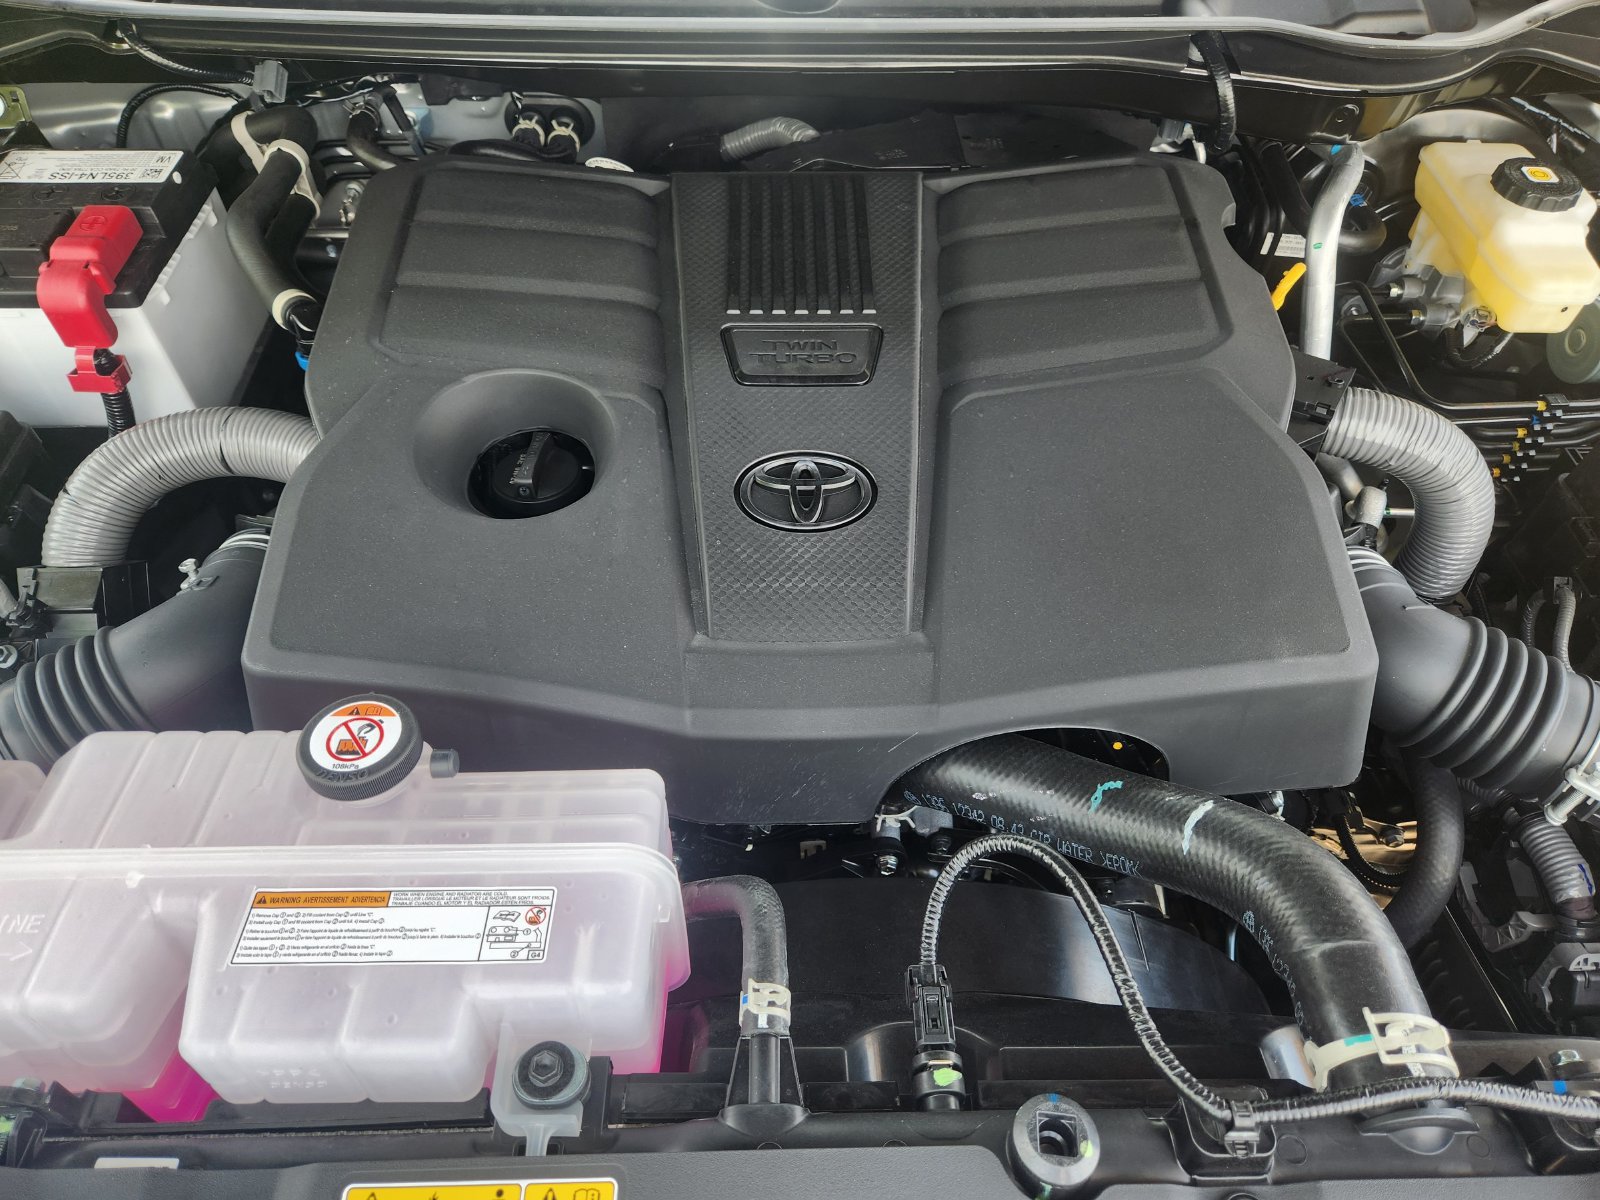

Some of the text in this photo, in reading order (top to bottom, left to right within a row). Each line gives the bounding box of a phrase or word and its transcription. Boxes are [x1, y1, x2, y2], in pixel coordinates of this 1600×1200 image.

[48, 172, 134, 180] 395LN4-ISS
[761, 339, 838, 351] TWIN
[748, 352, 857, 364] TURBO
[269, 895, 385, 904] WARNING AVERTISSEMENT ADVERTENCIA
